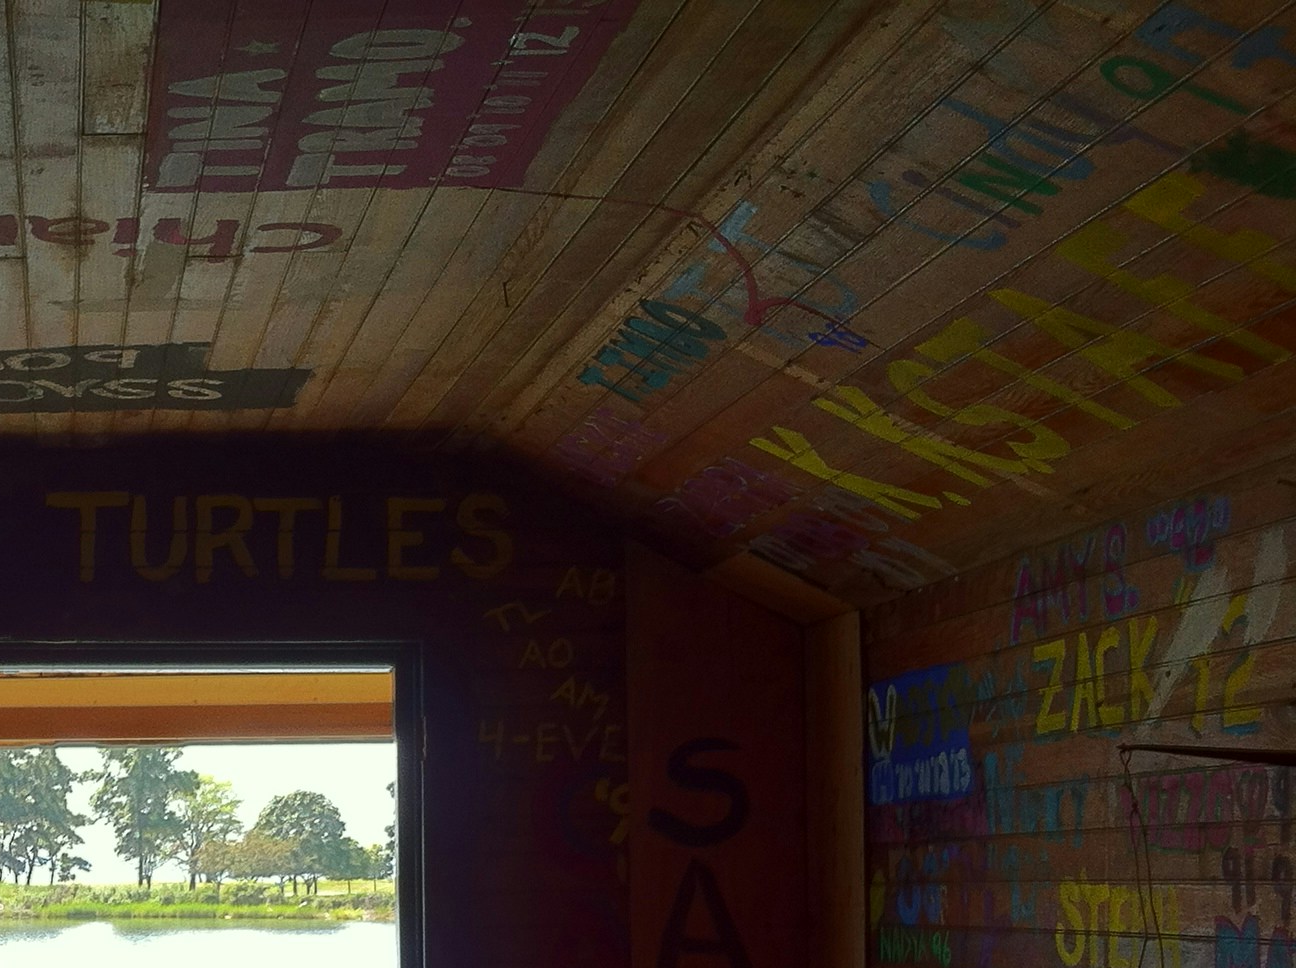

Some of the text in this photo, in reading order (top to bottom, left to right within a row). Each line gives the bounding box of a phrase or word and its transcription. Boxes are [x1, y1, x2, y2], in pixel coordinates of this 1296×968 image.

[157, 69, 286, 187] TINA
[45, 491, 513, 585] TURTLES
[1010, 537, 1099, 645] AMY
[1032, 616, 1160, 736] ZACK
